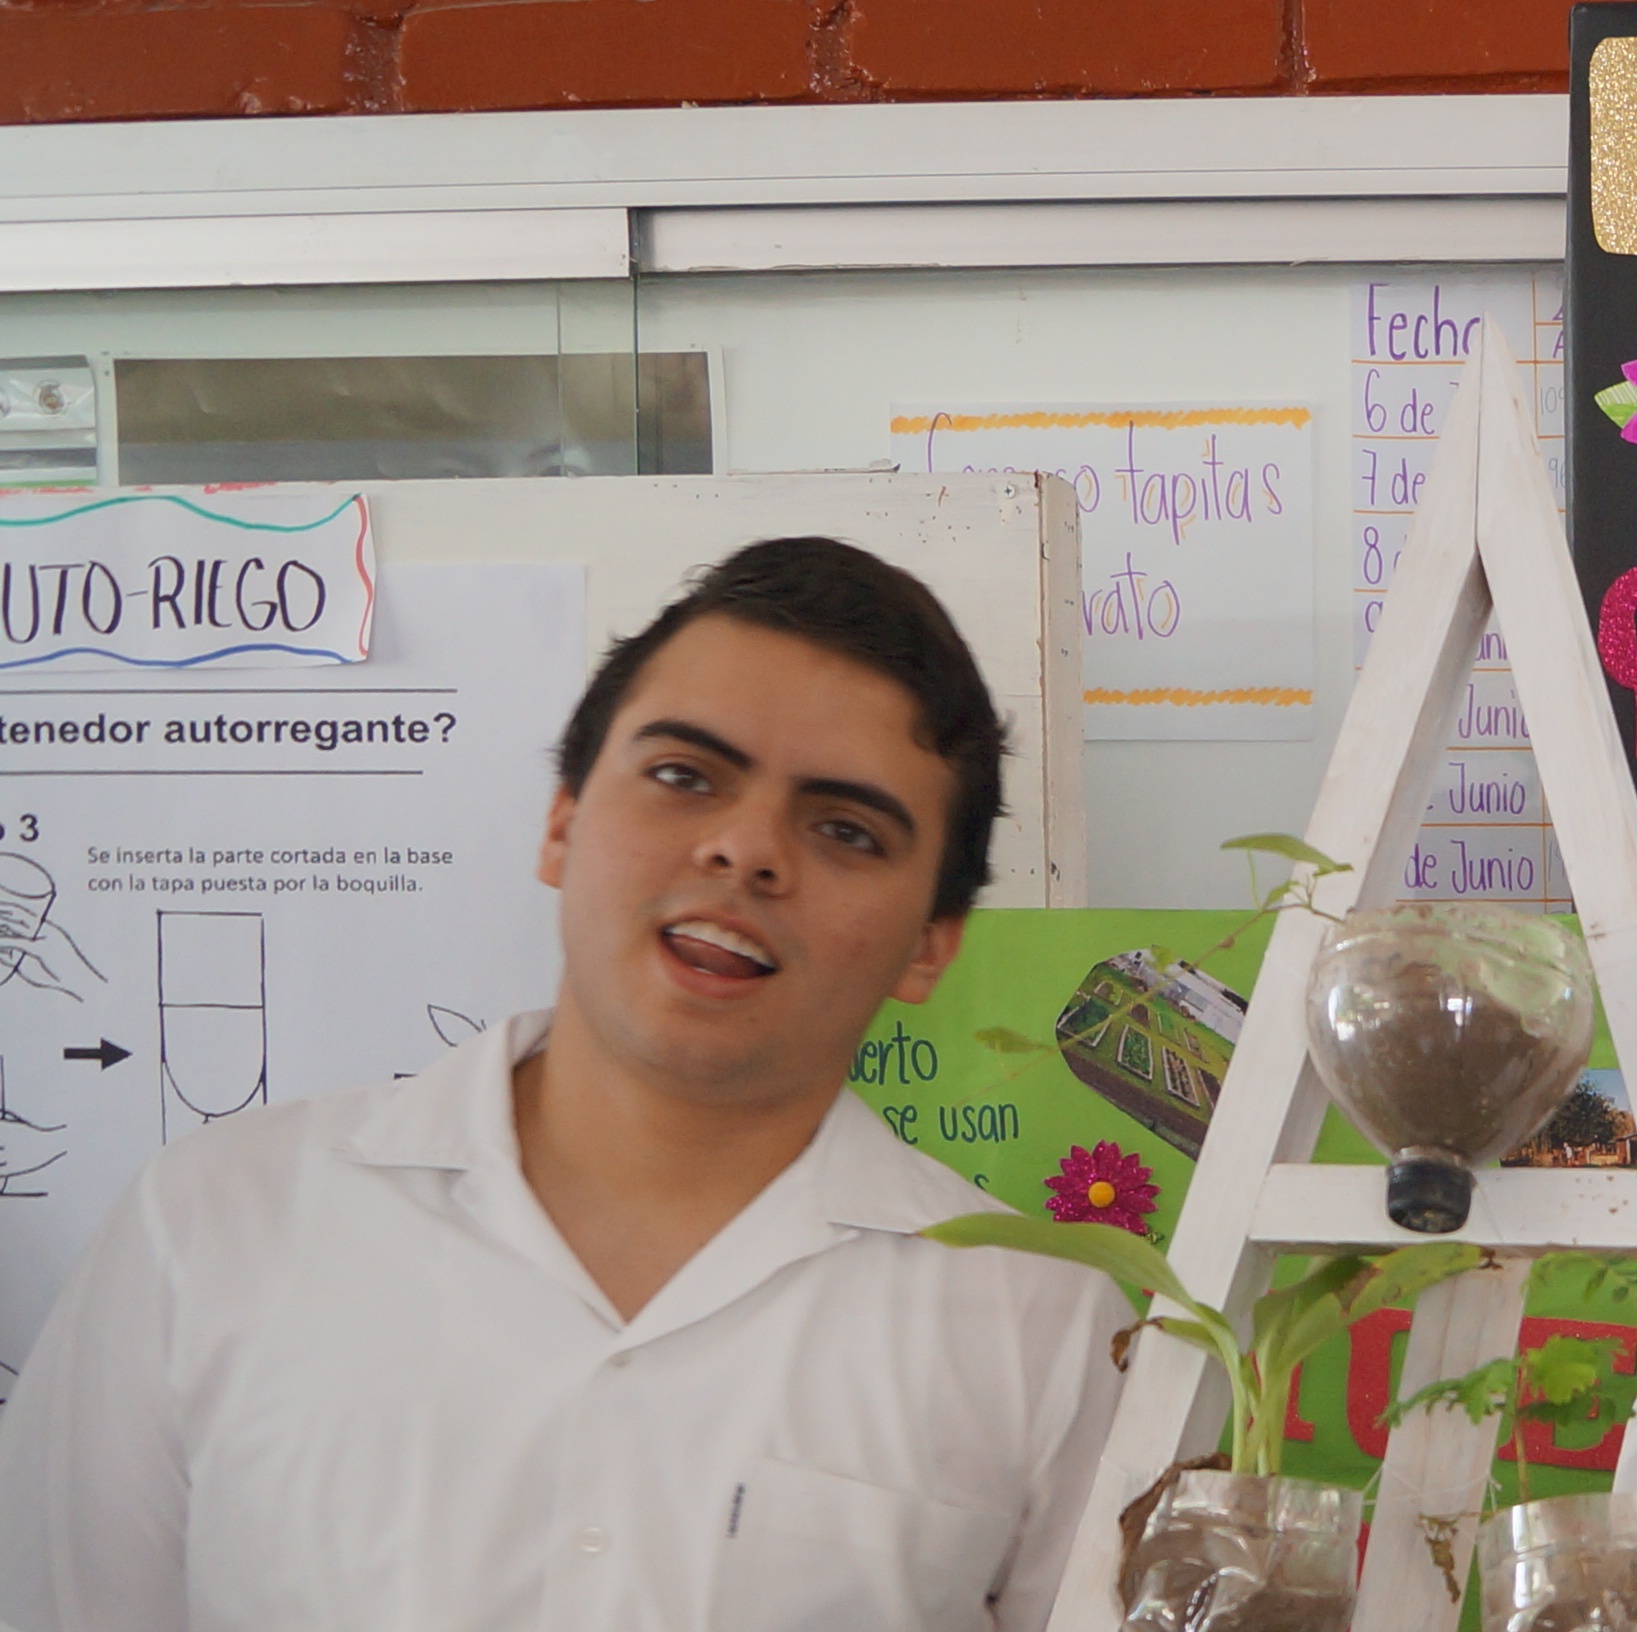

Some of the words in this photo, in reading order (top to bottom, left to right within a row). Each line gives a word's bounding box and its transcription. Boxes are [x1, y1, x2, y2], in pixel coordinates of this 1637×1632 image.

[1364, 368, 1388, 433] 6
[1400, 388, 1436, 436] de
[1114, 420, 1283, 546] tapitas
[1361, 448, 1378, 506] 7
[1363, 525, 1384, 585] 8
[0, 712, 152, 745] tenedor
[163, 712, 458, 751] autorregante?
[1448, 761, 1527, 815] Junio
[19, 813, 40, 843] 3
[87, 847, 111, 865] Se
[115, 847, 184, 865] inserta
[188, 847, 206, 865] la
[212, 849, 264, 869] parte
[270, 846, 347, 865] cortada
[353, 850, 376, 865] en
[383, 846, 402, 865] la
[406, 846, 454, 865] base
[1403, 843, 1438, 890] de
[1451, 840, 1535, 895] Junio
[87, 876, 123, 892] con
[128, 873, 147, 892] la
[151, 875, 196, 898] tapa
[200, 875, 268, 898] puesta
[273, 876, 307, 898] por
[312, 873, 331, 892] la
[336, 873, 425, 898] boquilla.
[882, 1104, 919, 1145] se
[939, 1103, 1020, 1144] usan
